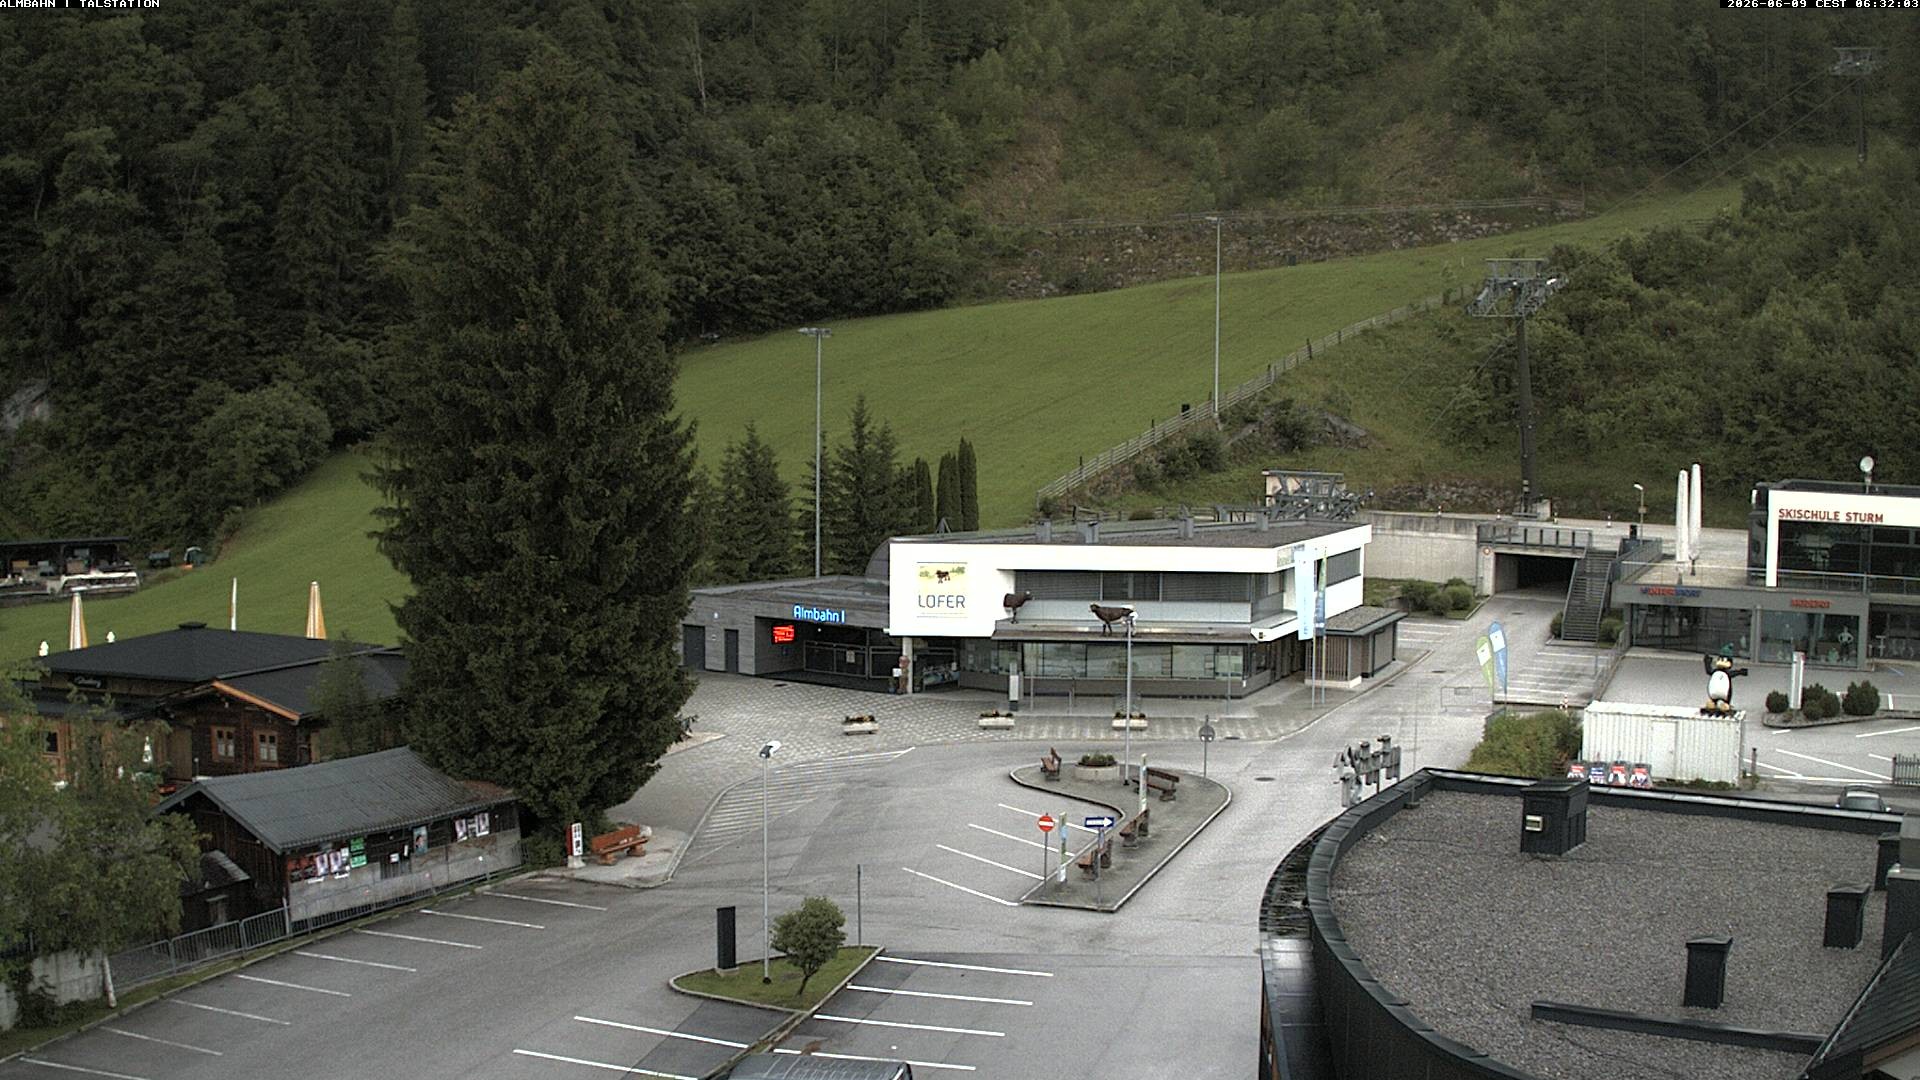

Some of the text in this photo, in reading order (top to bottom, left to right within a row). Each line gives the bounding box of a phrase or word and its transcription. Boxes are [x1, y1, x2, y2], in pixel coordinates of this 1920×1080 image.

[1778, 508, 1884, 523] SKISCHULE STURM
[918, 594, 966, 608] LOFER
[793, 605, 840, 622] Almbahn
